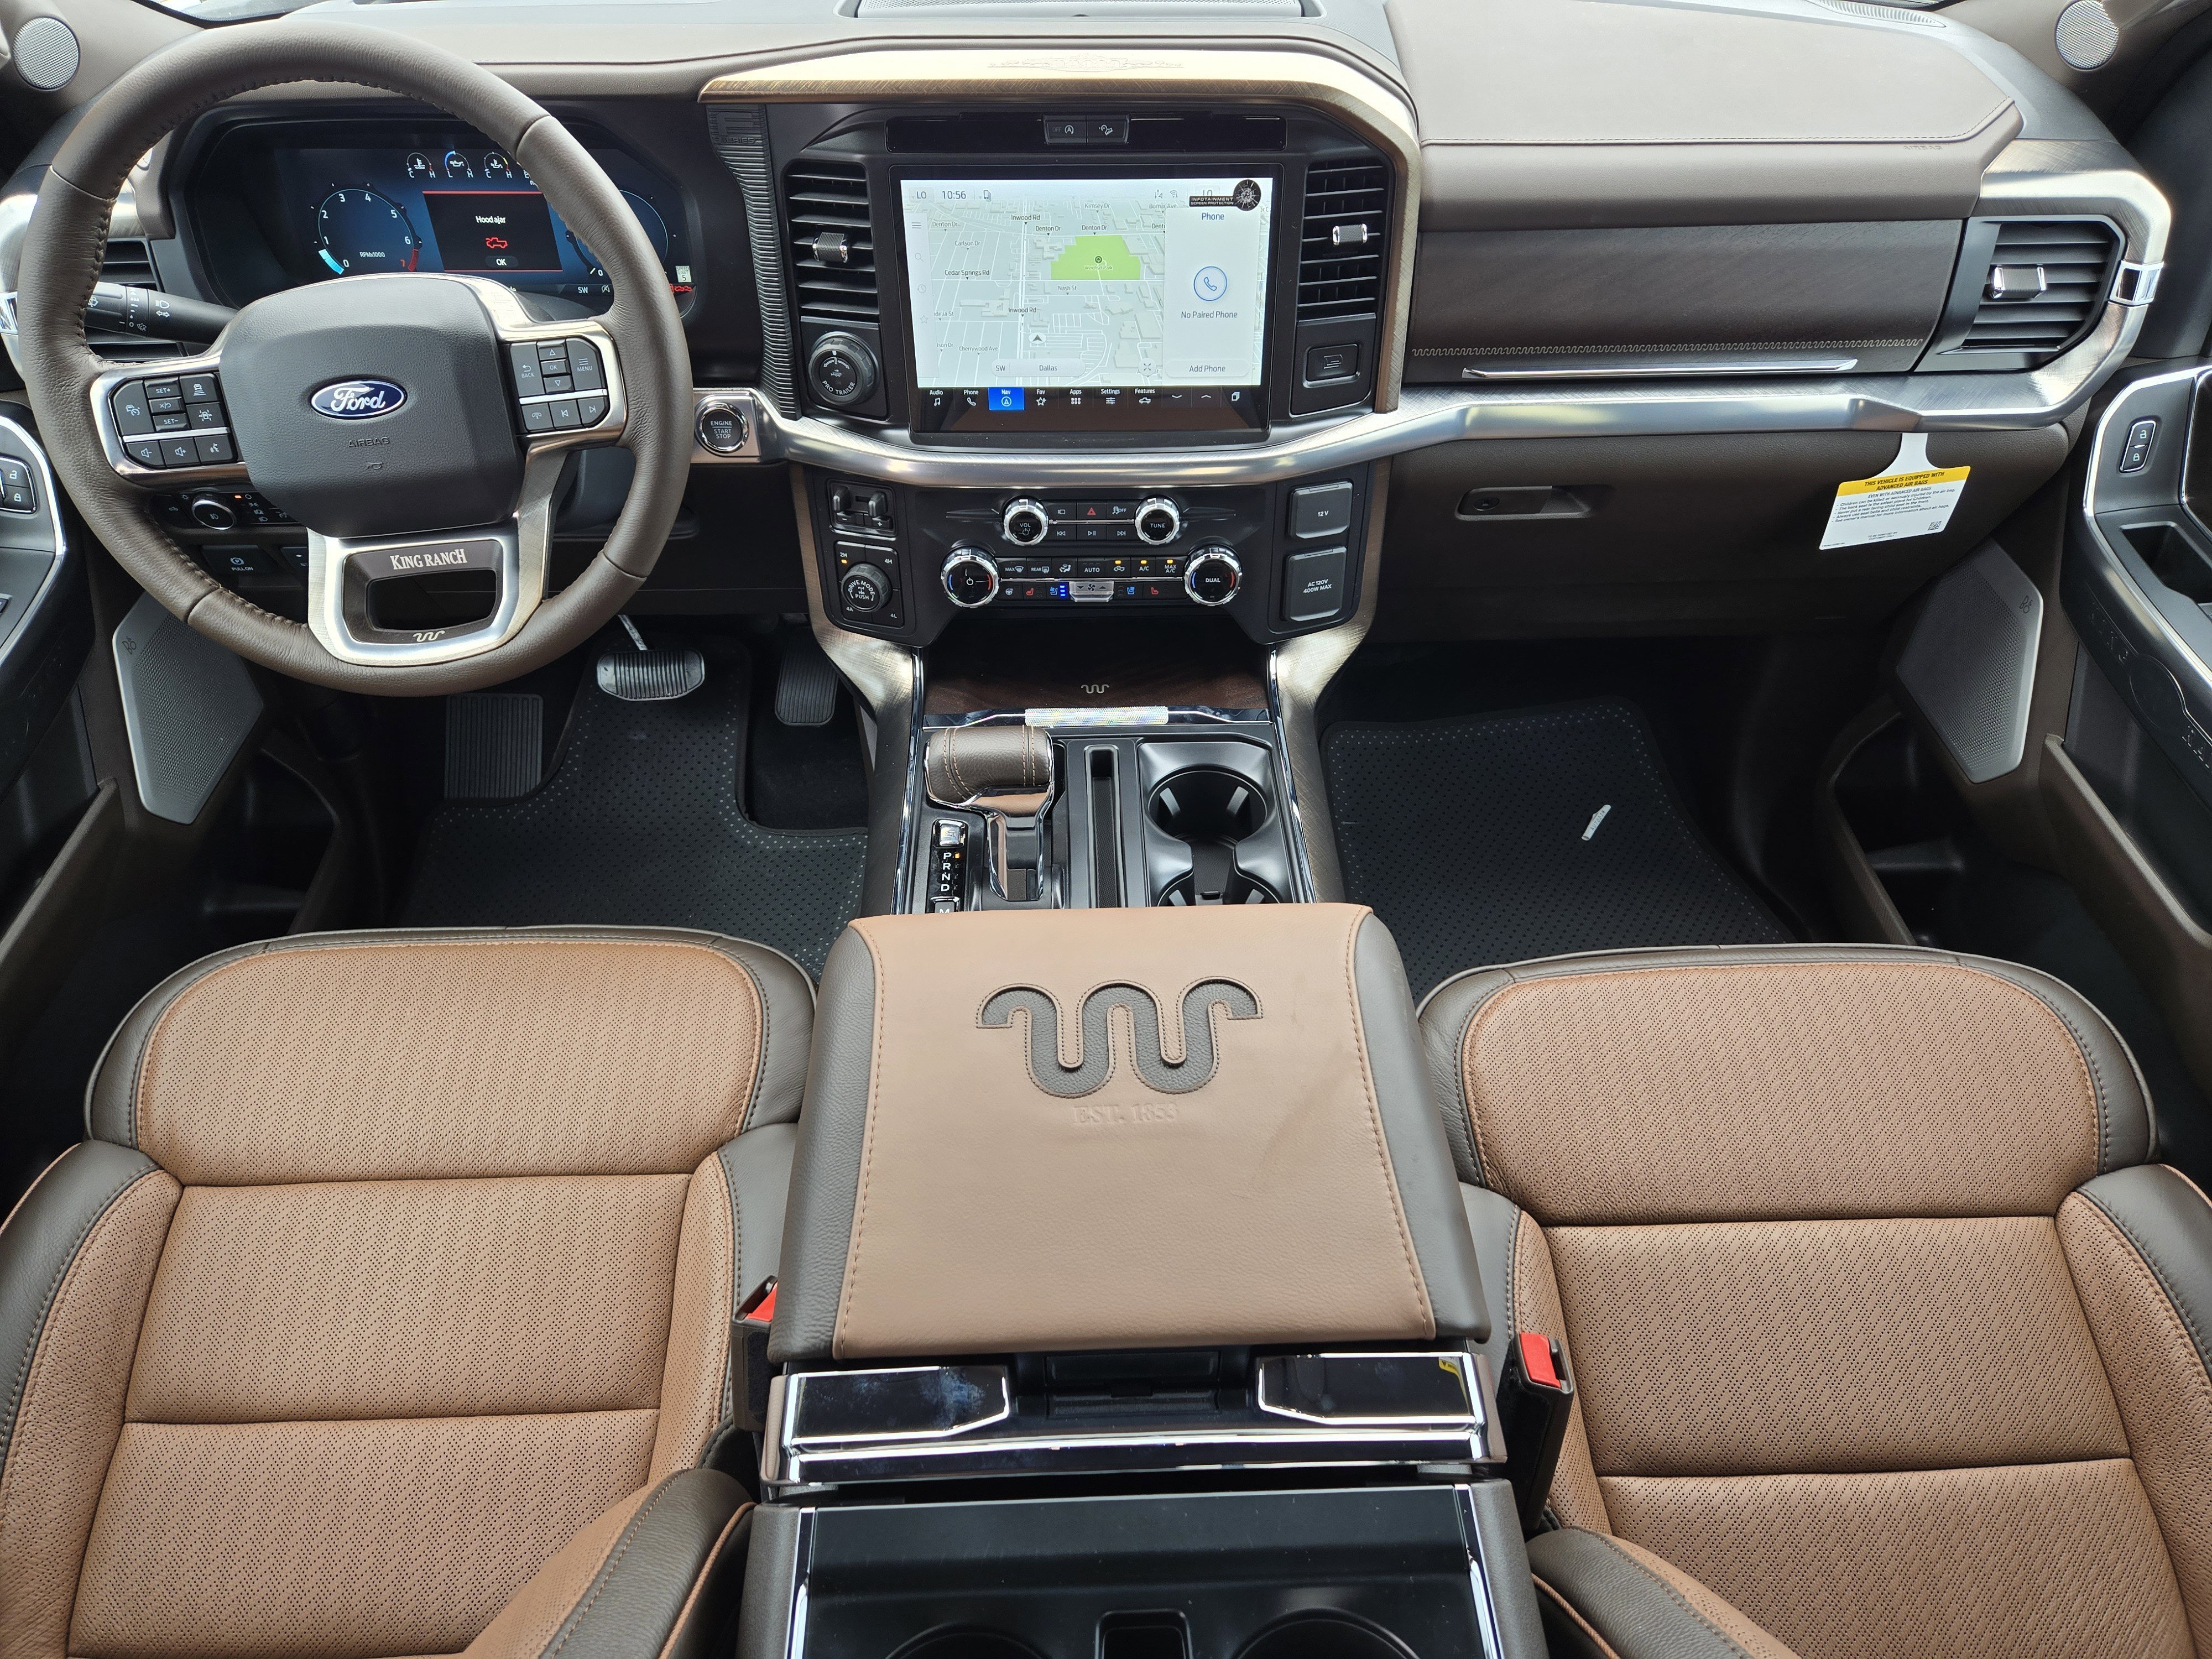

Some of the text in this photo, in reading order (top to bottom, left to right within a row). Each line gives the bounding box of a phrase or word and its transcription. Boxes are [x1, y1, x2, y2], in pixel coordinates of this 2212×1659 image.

[338, 194, 346, 202] 3
[365, 193, 372, 202] 4
[916, 191, 927, 199] LO
[942, 190, 967, 200] 10:56
[321, 210, 328, 218] 2
[390, 210, 397, 218] 5
[1202, 212, 1224, 221] Phone
[493, 216, 506, 224] ajar
[324, 236, 329, 245] 1
[404, 236, 411, 244] 6
[343, 259, 349, 268] 0
[822, 380, 855, 395] PRO TRAILER
[330, 386, 386, 412] Ford
[348, 436, 390, 448] AIRBAG
[389, 549, 468, 570] KING RANCH
[848, 580, 875, 595] DRIVE MODE
[1072, 1102, 1179, 1125] EST. 1853
